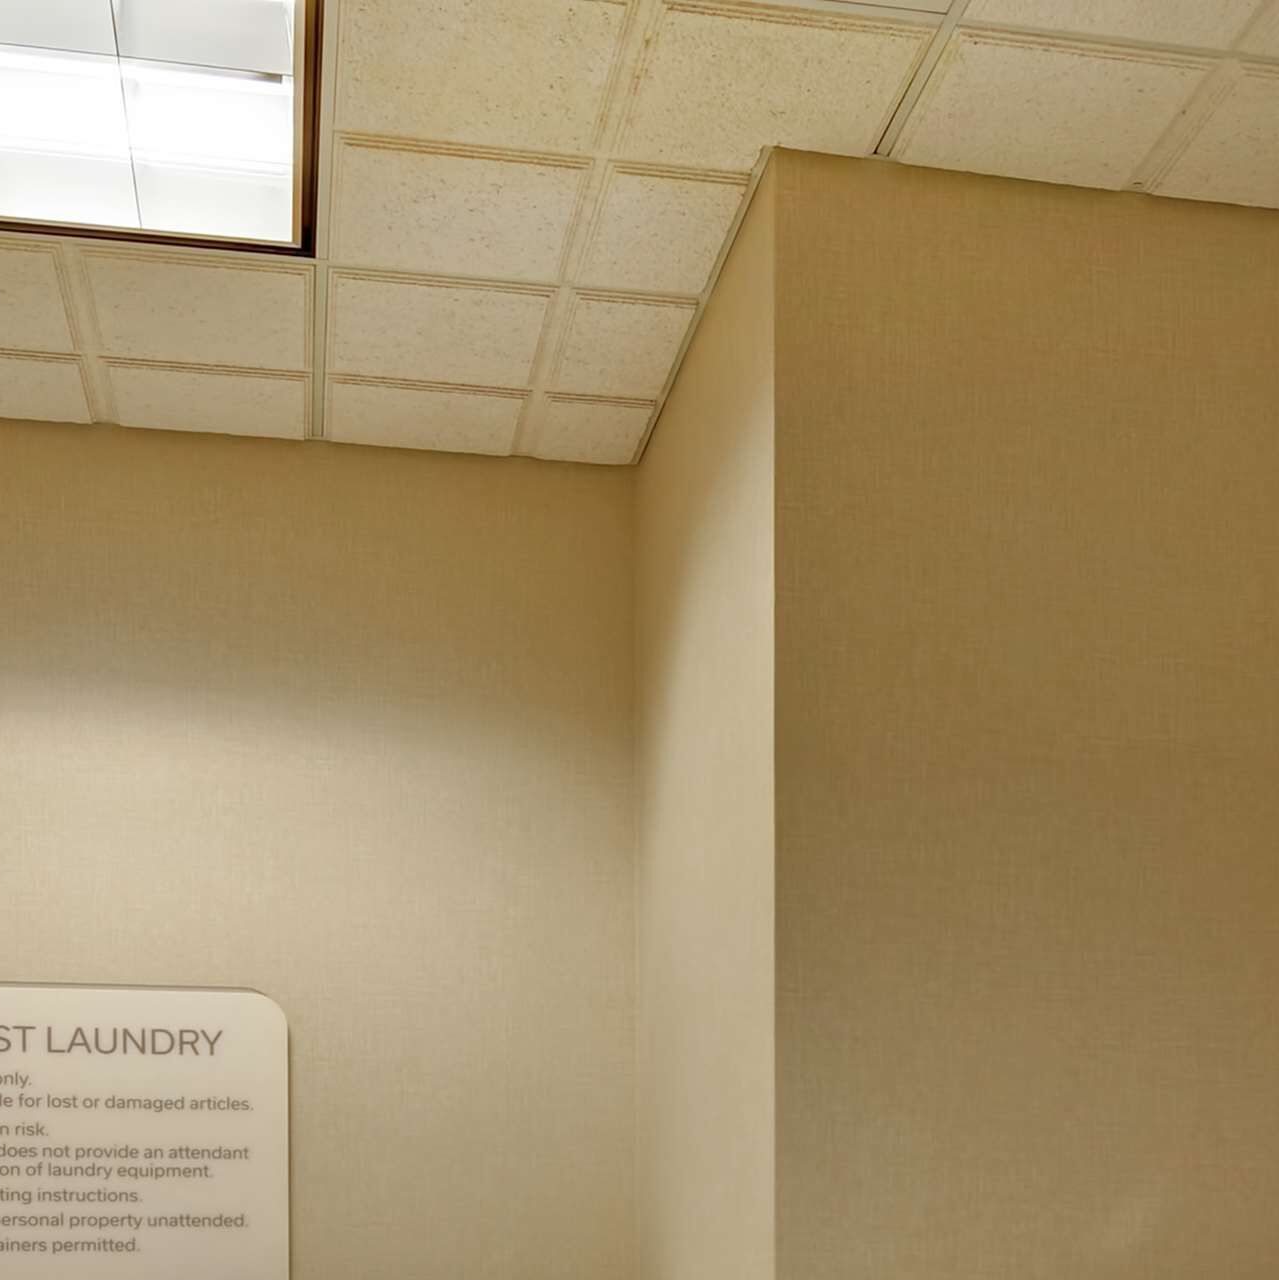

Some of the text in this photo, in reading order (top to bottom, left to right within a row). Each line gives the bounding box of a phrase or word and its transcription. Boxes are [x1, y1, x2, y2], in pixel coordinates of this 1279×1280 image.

[46, 1025, 224, 1057] LAUNDRY
[17, 1092, 43, 1109] for
[46, 1093, 79, 1109] lost
[81, 1097, 100, 1109] or
[104, 1094, 185, 1113] damaged
[189, 1096, 254, 1111] articles.
[14, 1121, 49, 1137] risk.
[41, 1145, 71, 1159] not
[74, 1144, 140, 1161] provide
[143, 1147, 164, 1160] an
[167, 1145, 249, 1160] attendant
[25, 1161, 44, 1177] of
[47, 1162, 113, 1180] laundry
[116, 1162, 214, 1181] equipment.
[37, 1187, 143, 1203] instructions.
[68, 1213, 144, 1231] property
[146, 1213, 248, 1228] unattended.
[51, 1237, 140, 1255] permitted.
